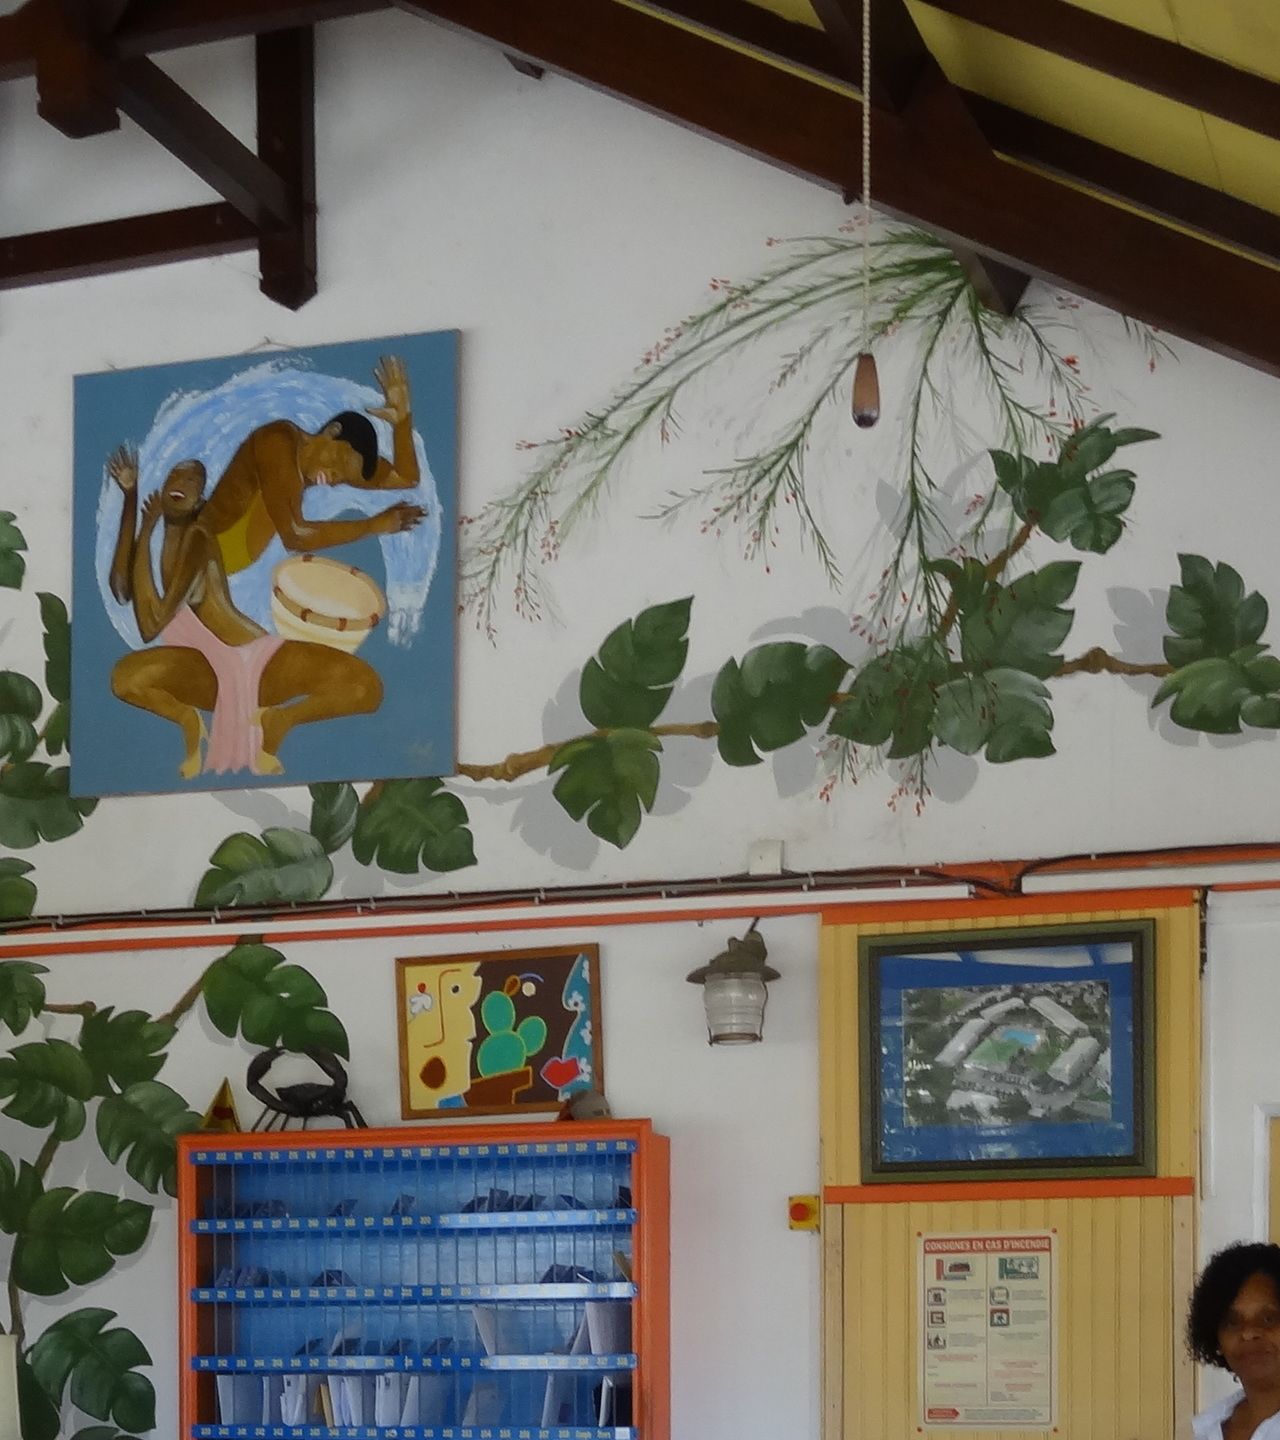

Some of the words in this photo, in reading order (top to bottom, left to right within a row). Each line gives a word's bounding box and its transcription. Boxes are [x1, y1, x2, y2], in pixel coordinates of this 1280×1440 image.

[925, 1240, 970, 1252] CONSIGNES
[971, 1240, 984, 1251] EN
[985, 1239, 1002, 1251] CAS
[1003, 1238, 1050, 1250] D'INCENDIE
